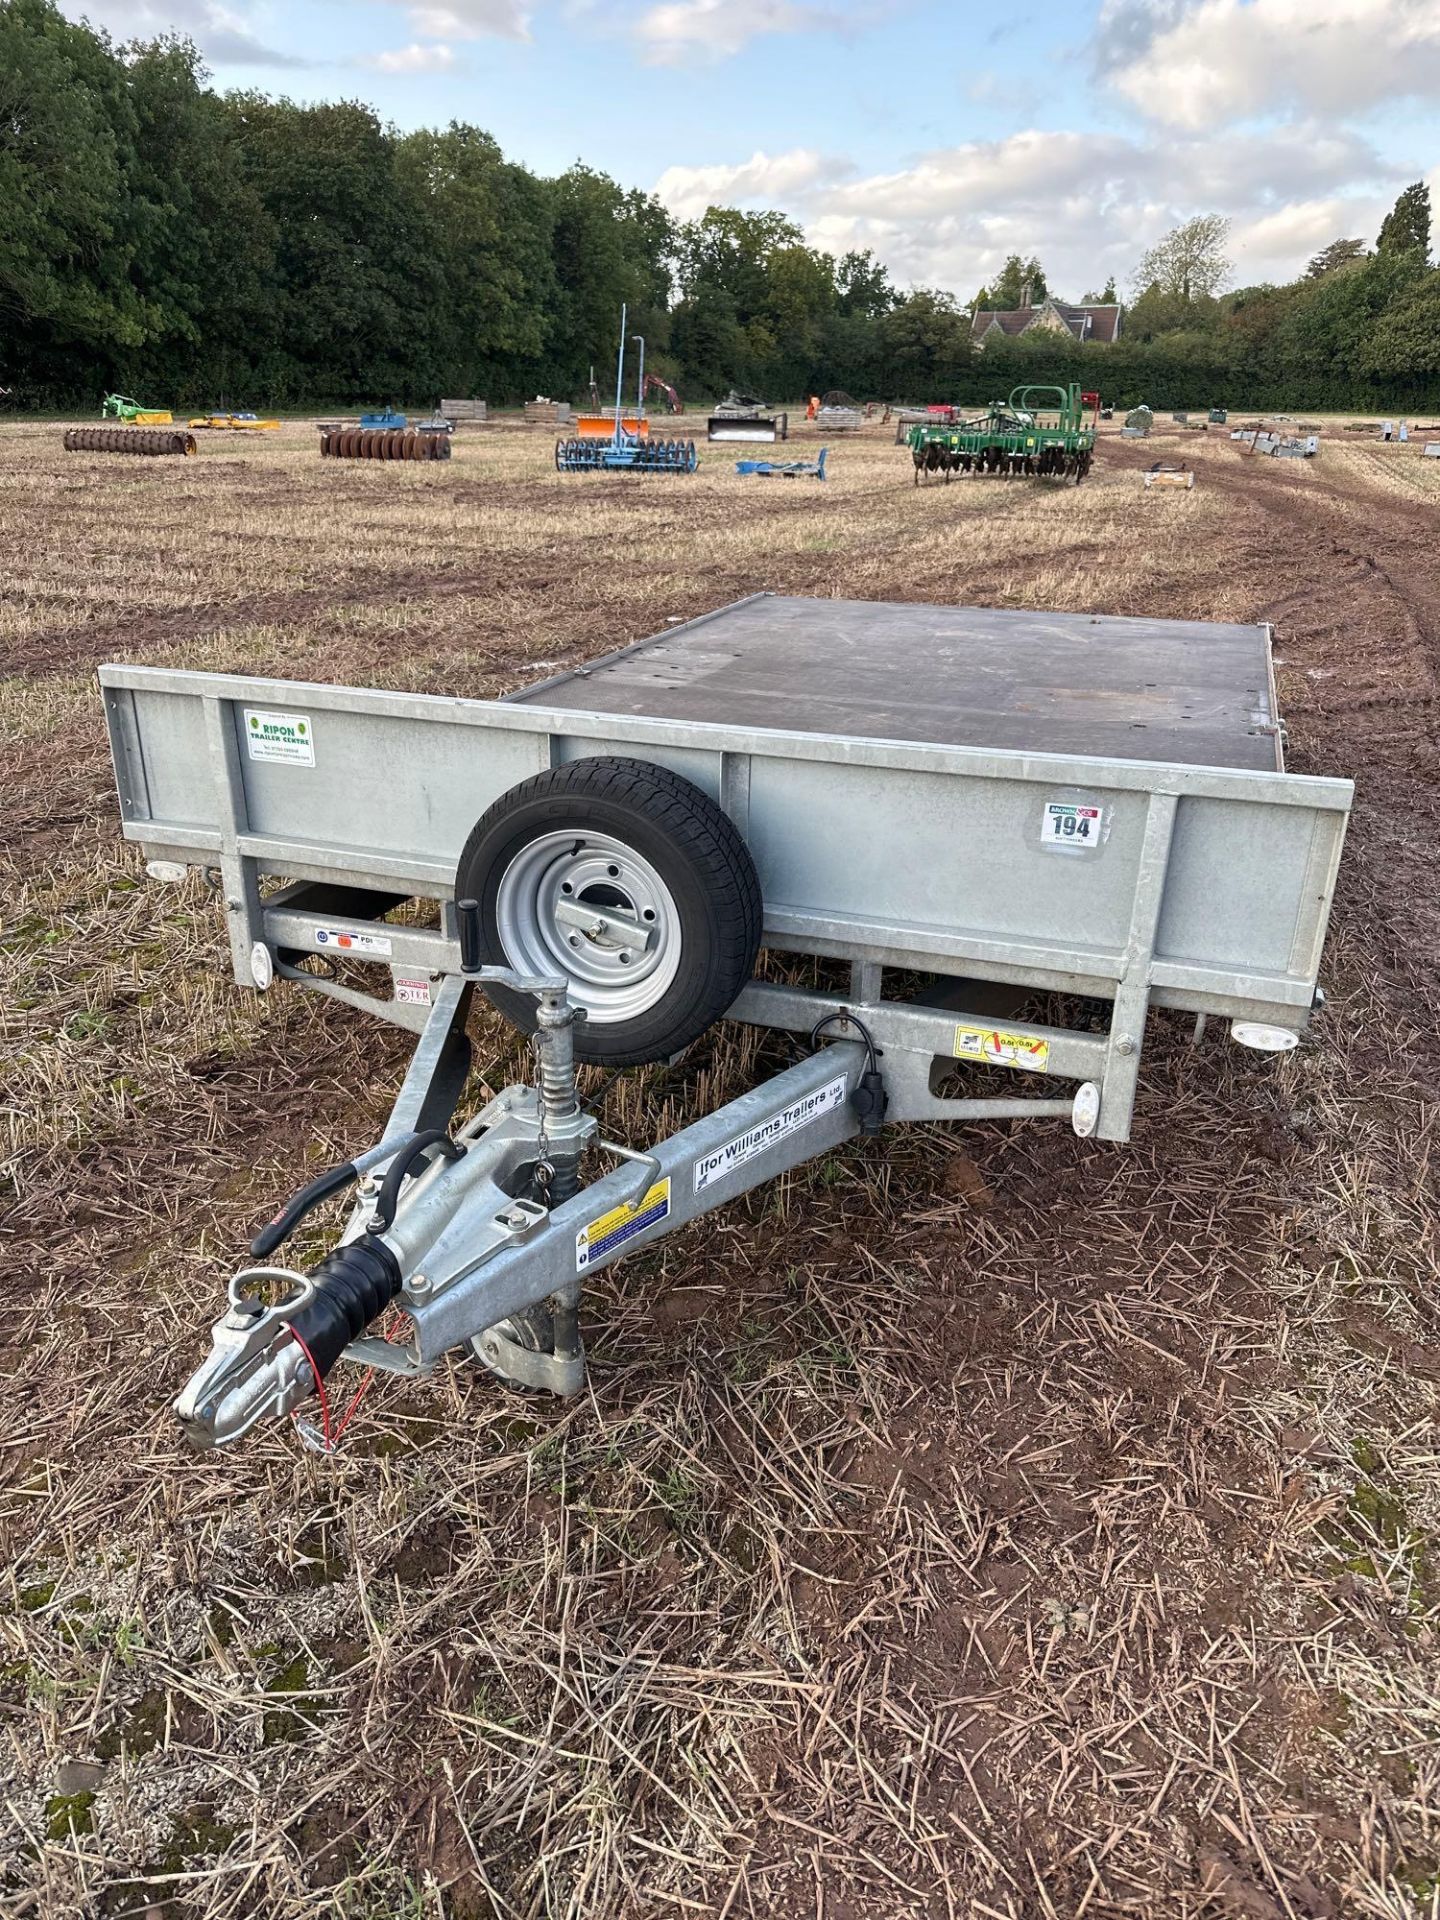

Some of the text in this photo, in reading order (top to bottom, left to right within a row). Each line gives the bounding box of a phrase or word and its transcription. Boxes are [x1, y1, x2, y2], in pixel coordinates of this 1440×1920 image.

[250, 733, 309, 745] TRAILER CENTRE
[263, 725, 295, 737] RIPON
[1053, 815, 1089, 837] 194
[700, 1153, 724, 1175] Ifor
[725, 1118, 780, 1159] Williams
[782, 1091, 826, 1124] Trailers
[829, 1085, 842, 1097] Ltd.
